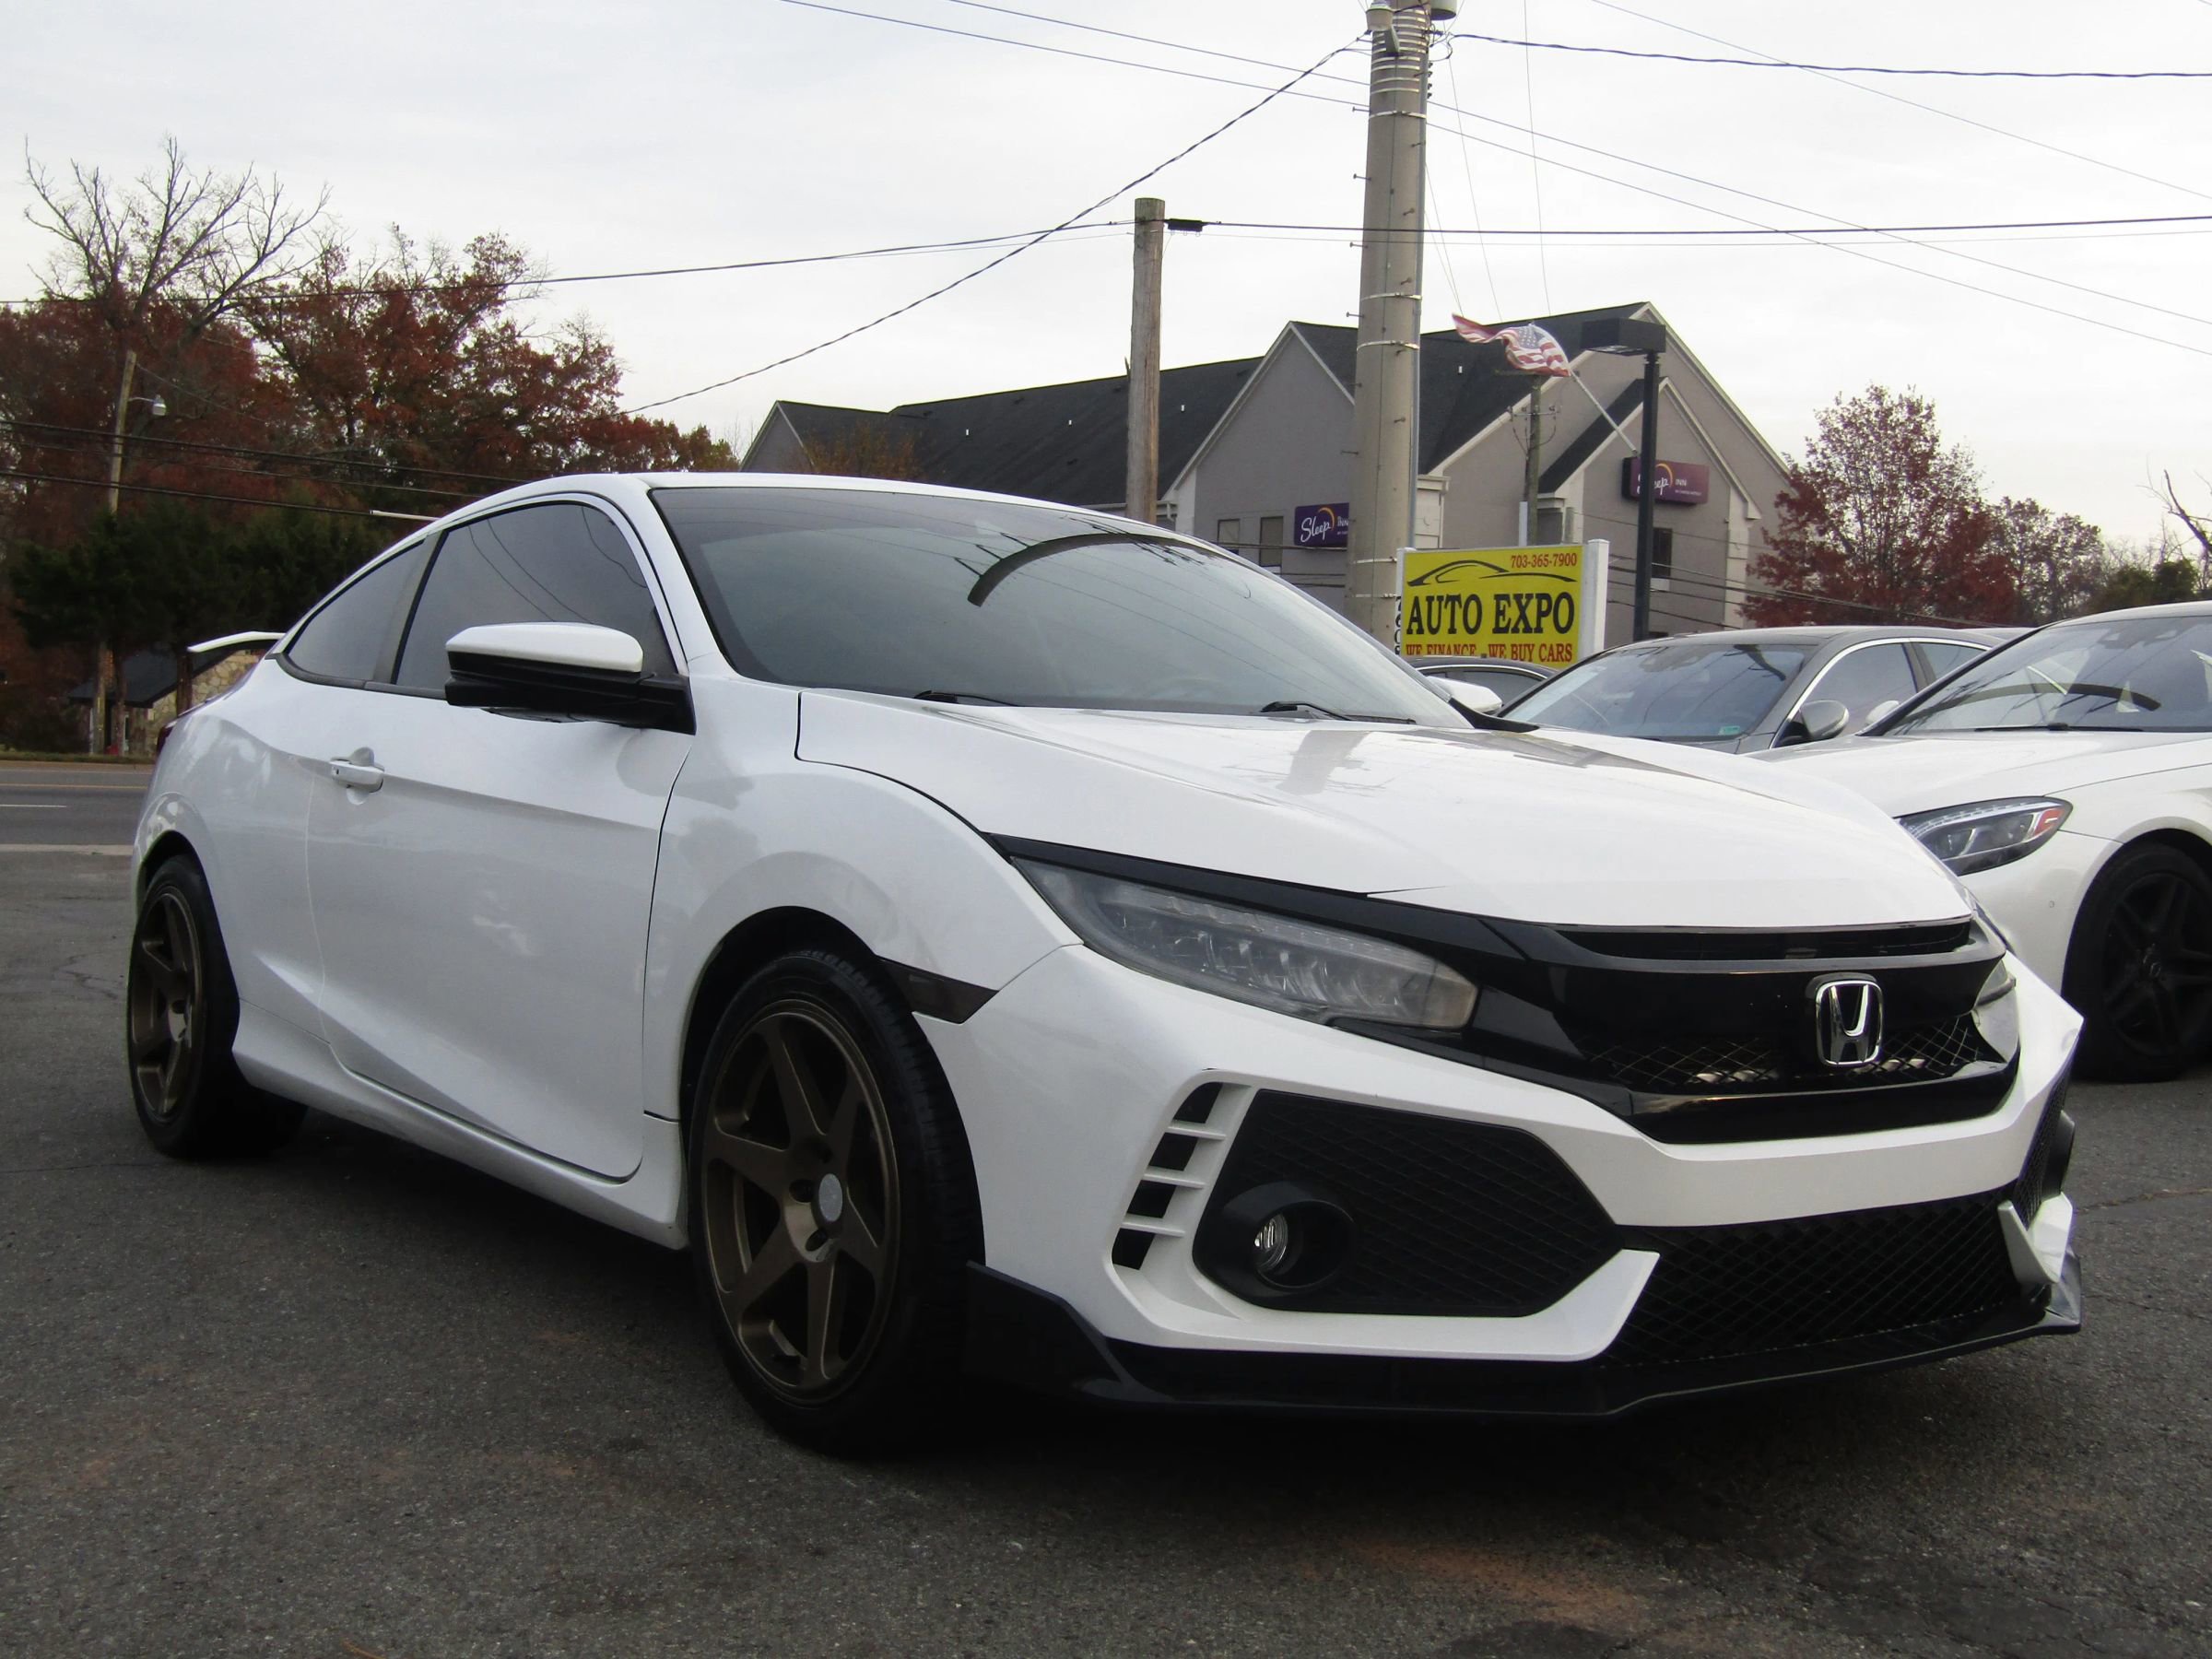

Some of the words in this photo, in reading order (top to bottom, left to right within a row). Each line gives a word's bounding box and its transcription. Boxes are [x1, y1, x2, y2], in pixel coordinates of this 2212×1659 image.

[1300, 516, 1332, 543] Sleep
[1511, 552, 1577, 569] 703-365-7900
[1406, 594, 1483, 635] AUTO
[1492, 591, 1575, 634] EXPO
[1406, 643, 1423, 656] WE
[1427, 643, 1477, 656] FINANCE
[1488, 643, 1507, 659] WE
[1511, 642, 1535, 662] BUY
[1538, 642, 1573, 663] CARS
